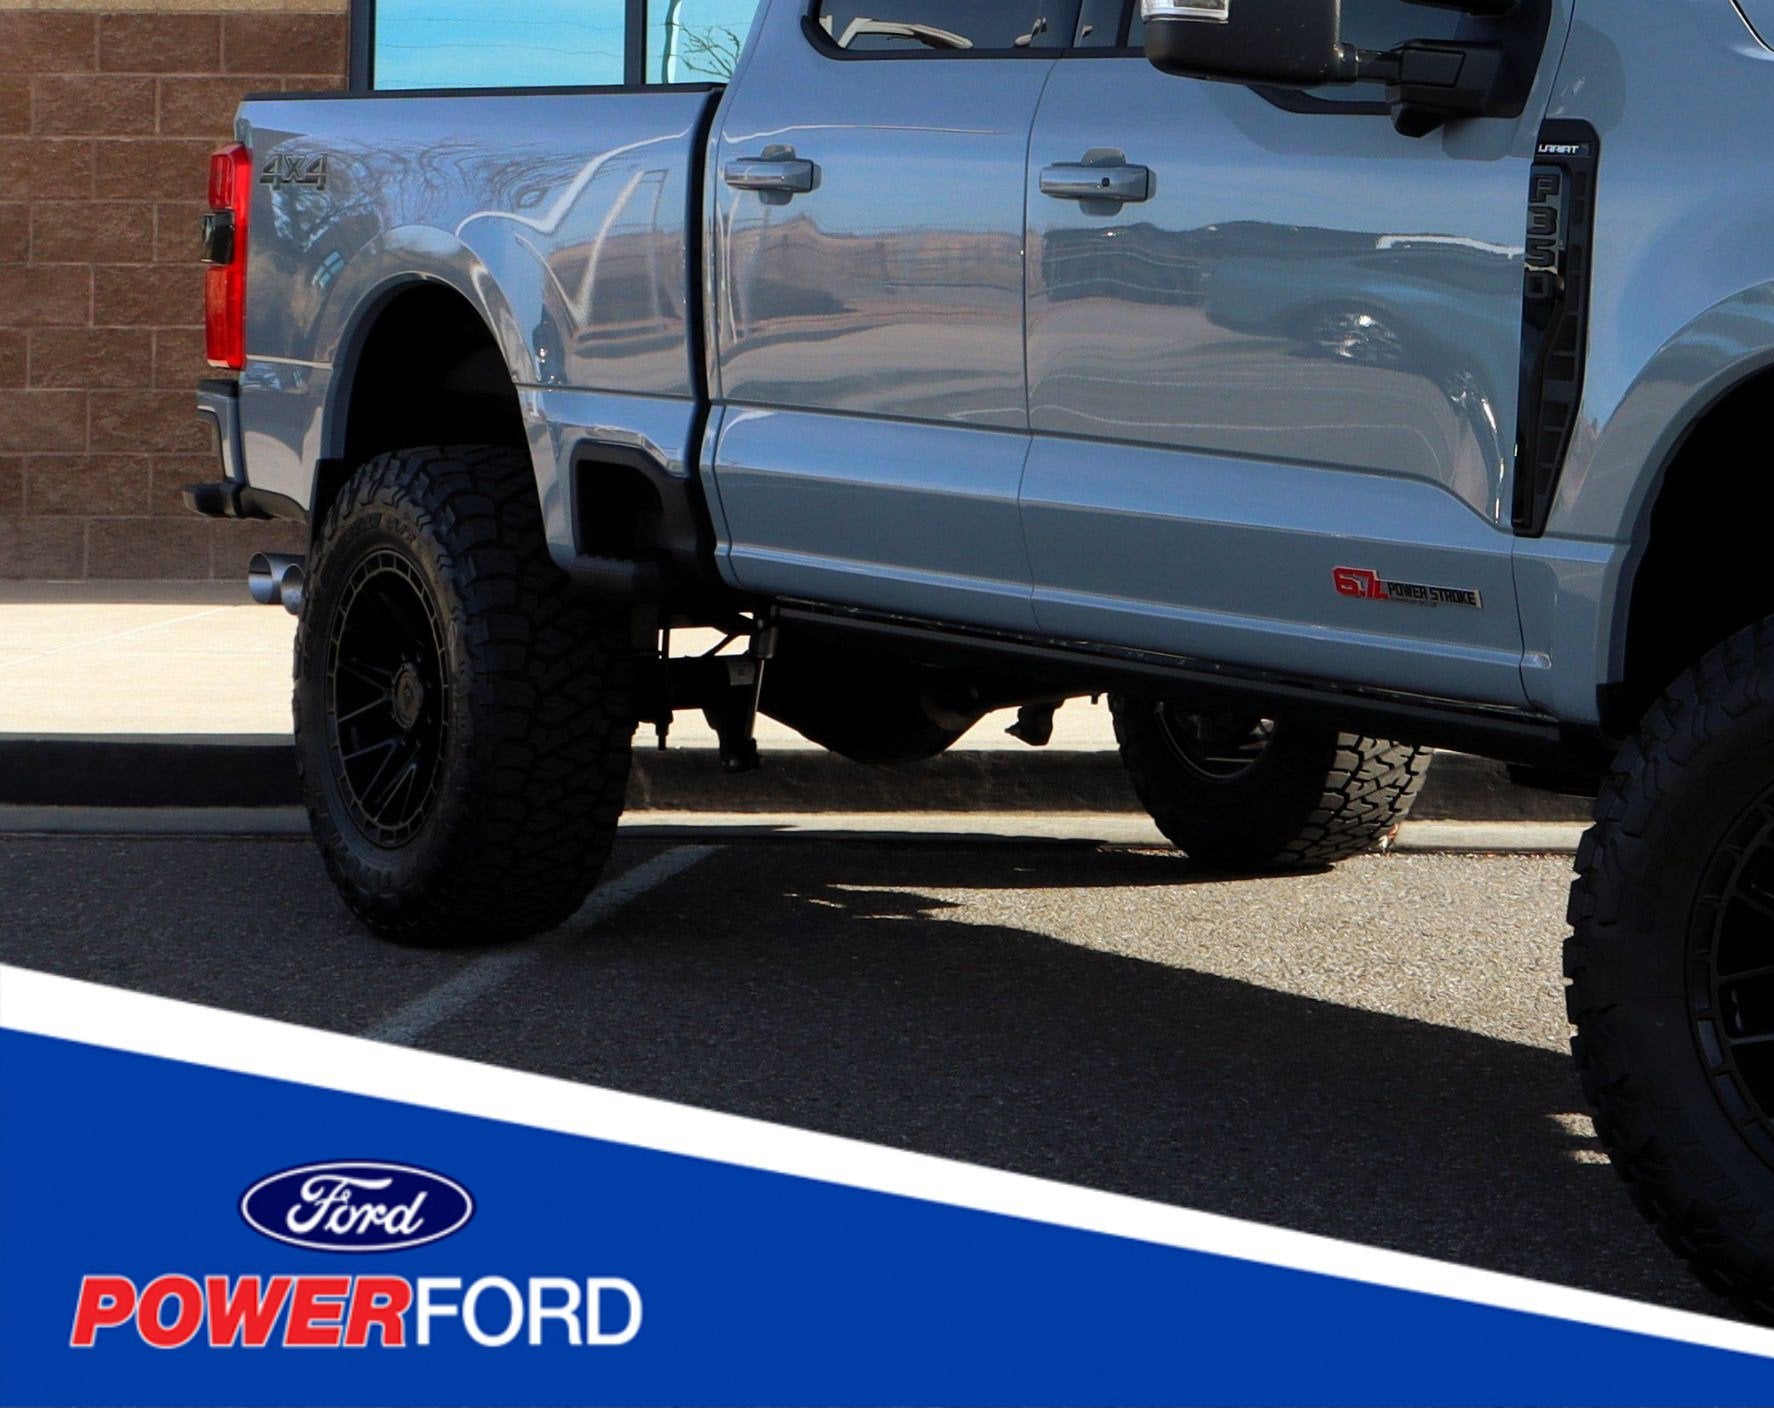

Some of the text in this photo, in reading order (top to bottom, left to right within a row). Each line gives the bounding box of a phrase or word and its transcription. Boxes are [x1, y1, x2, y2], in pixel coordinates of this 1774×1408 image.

[1538, 144, 1579, 153] LARIAT
[1388, 581, 1429, 599] POWER
[1430, 587, 1477, 606] STROKE
